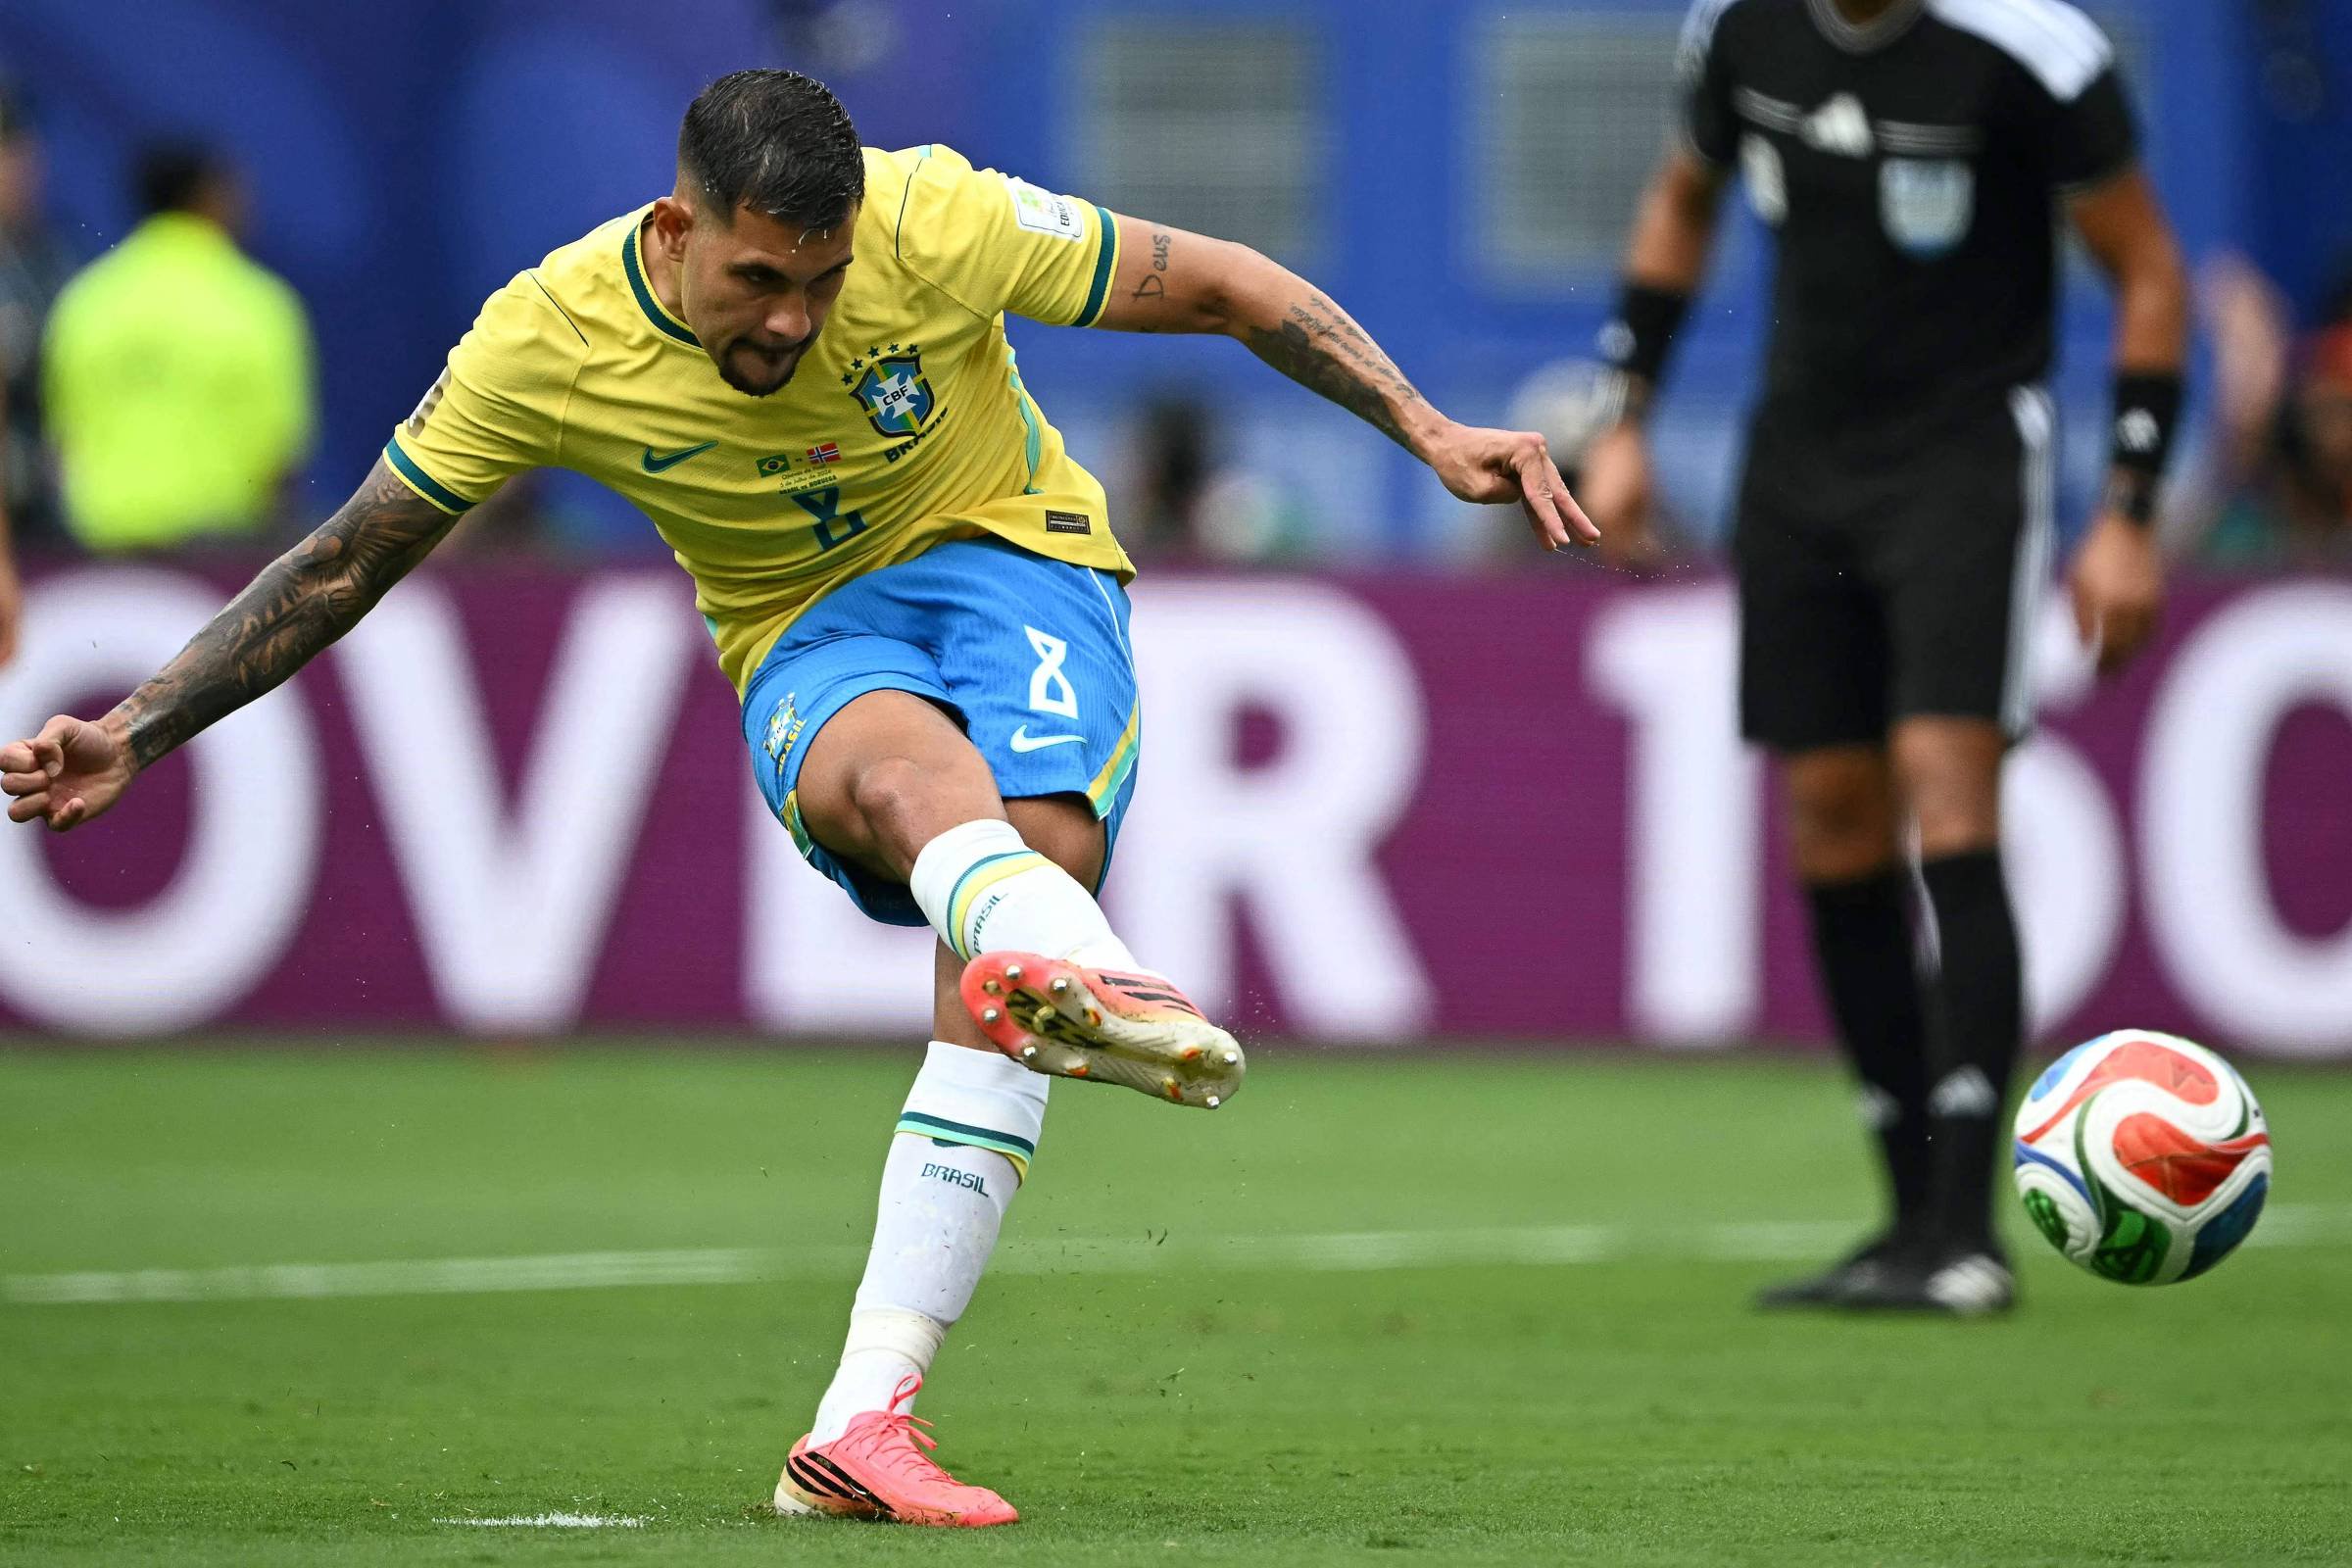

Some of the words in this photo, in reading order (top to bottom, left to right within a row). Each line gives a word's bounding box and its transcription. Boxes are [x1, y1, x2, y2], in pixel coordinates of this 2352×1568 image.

[1133, 234, 1172, 302] Deus
[882, 385, 908, 407] CBF
[884, 407, 948, 464] BRA
[791, 486, 868, 551] 8
[1023, 624, 1079, 720] 8
[921, 1162, 989, 1198] BRASIL
